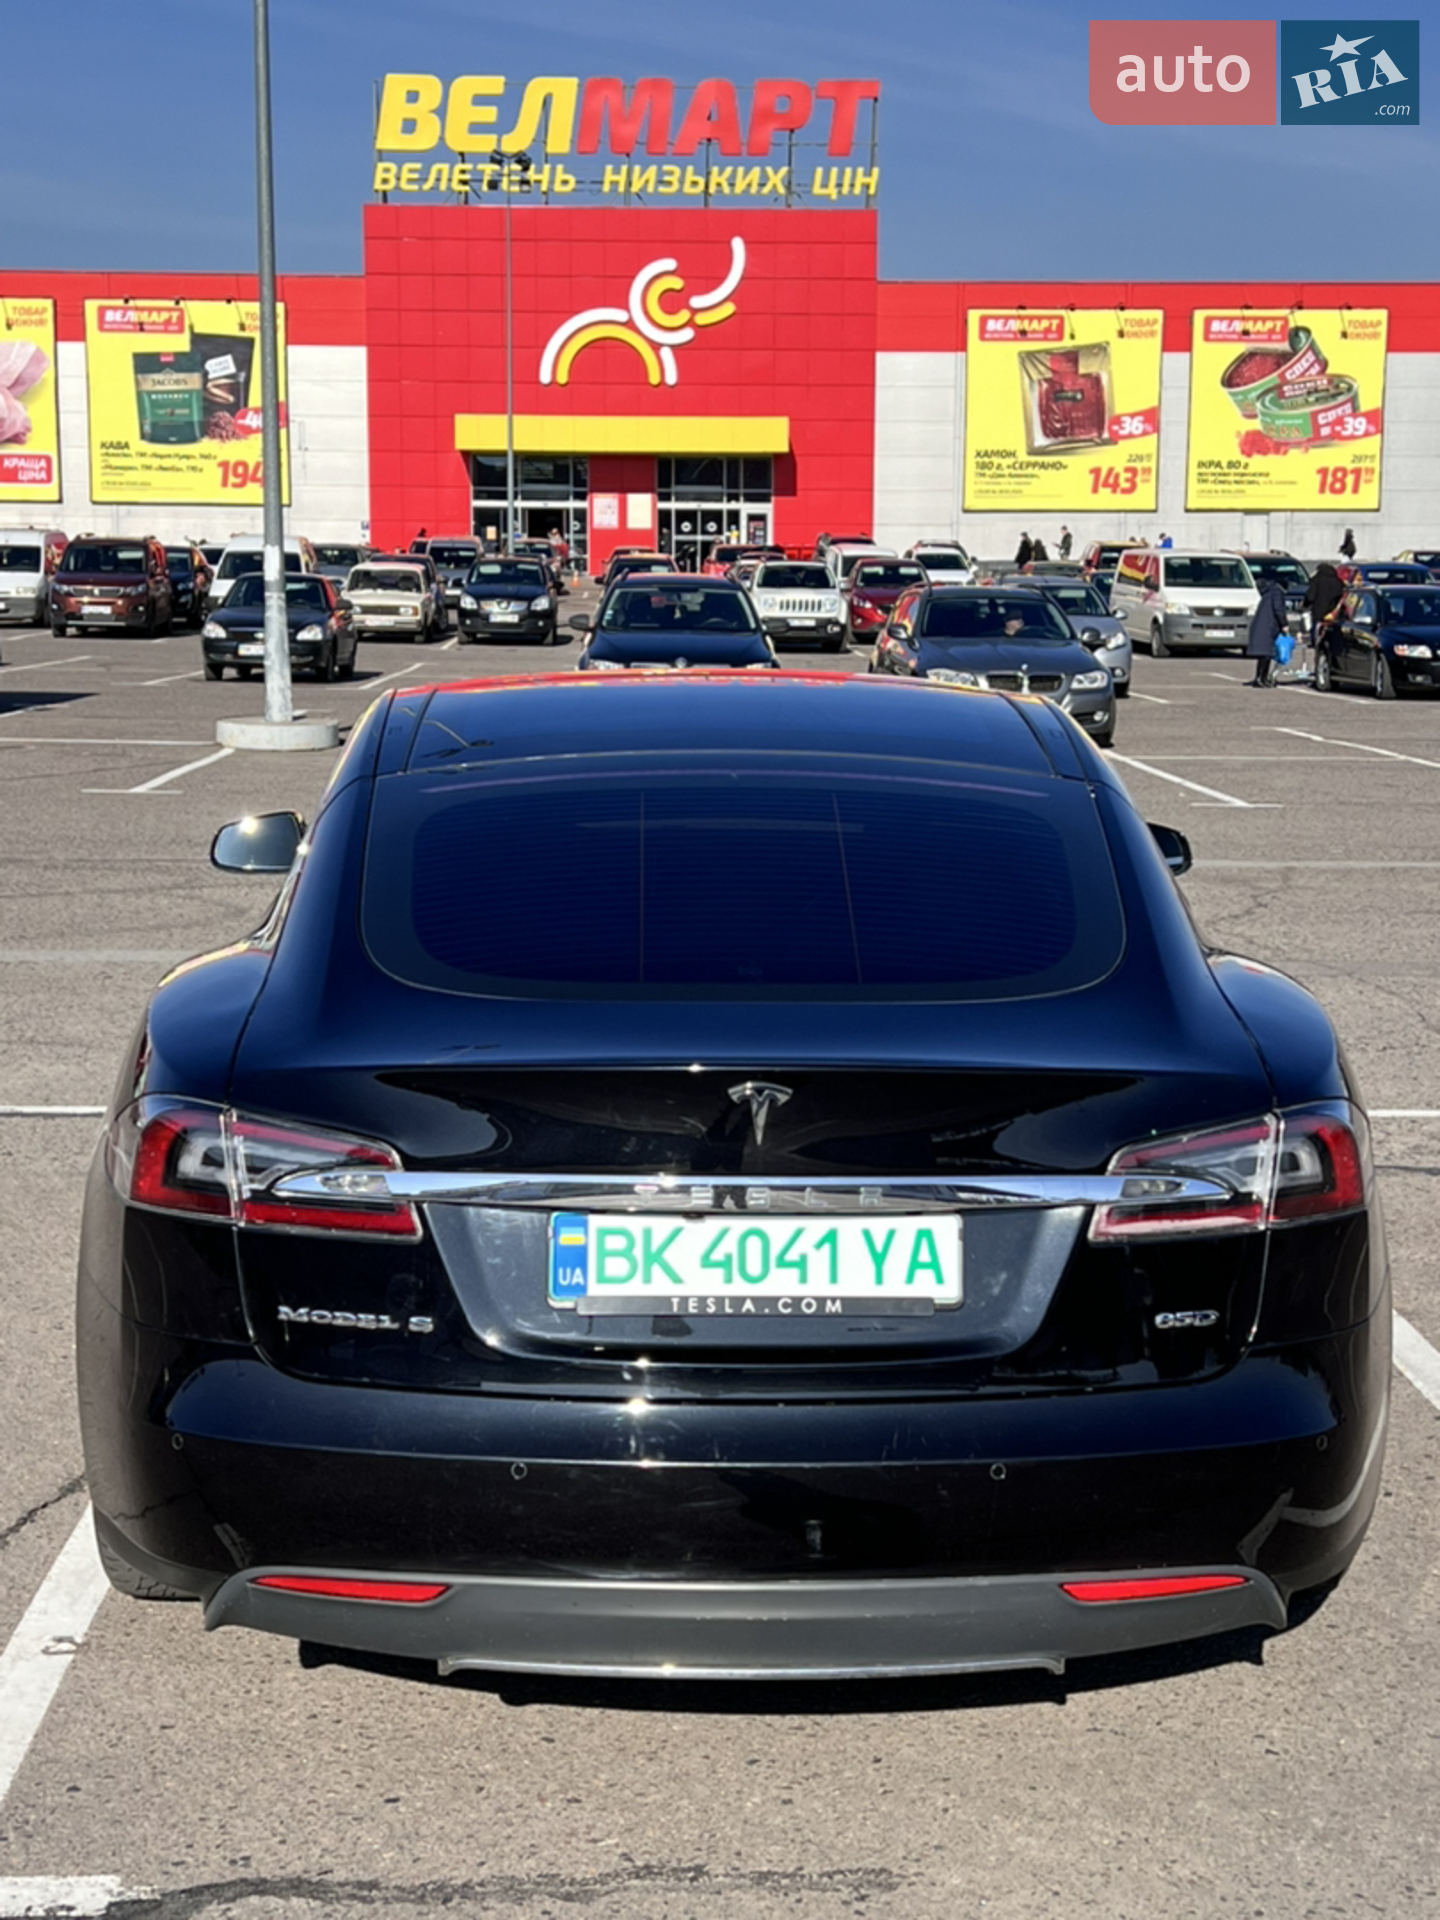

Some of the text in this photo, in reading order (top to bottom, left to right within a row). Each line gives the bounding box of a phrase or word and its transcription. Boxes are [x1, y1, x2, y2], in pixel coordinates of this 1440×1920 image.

[375, 73, 881, 157] ВЕЛМАРТ
[372, 162, 879, 200] ВЕЛЕТЕНЬ НИЗЬКИХ ЦІН
[104, 309, 180, 324] ВЕЛМАРТ
[986, 319, 1060, 332] ВЕЛМАРТ
[1210, 319, 1284, 332] ВЕЛМАРТ
[3, 457, 47, 469] КРАЩА
[1088, 466, 1139, 495] 143
[1316, 466, 1363, 495] 181
[595, 1226, 945, 1286] BK 4041 YA
[558, 1267, 585, 1286] UA
[277, 1305, 434, 1334] MODEL S
